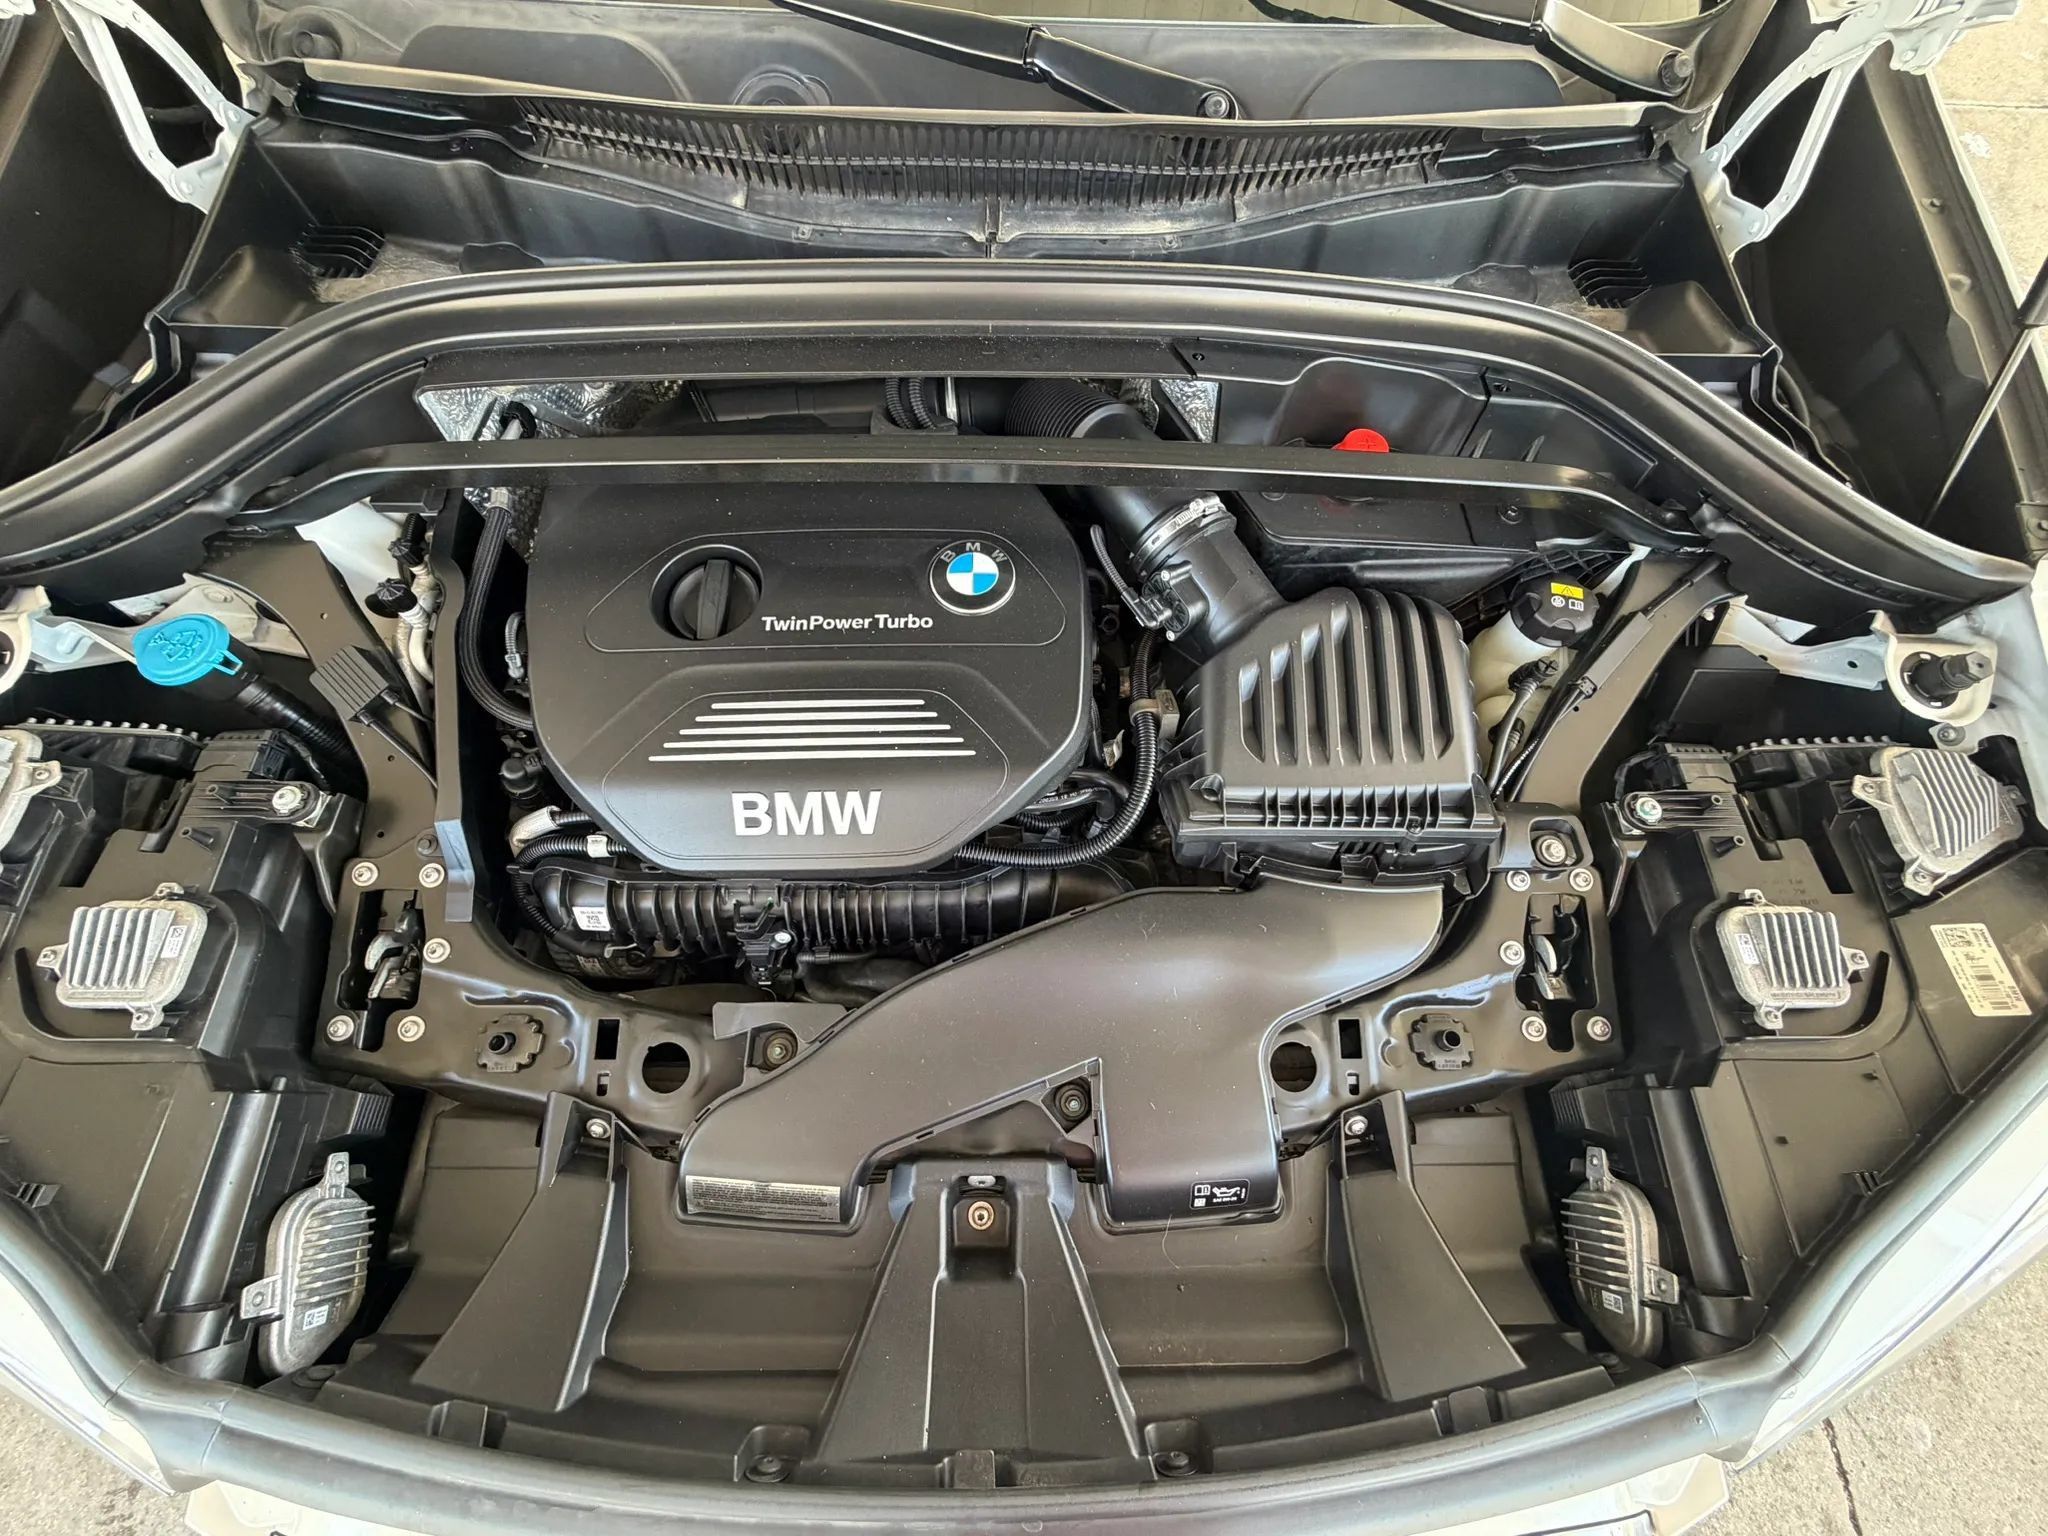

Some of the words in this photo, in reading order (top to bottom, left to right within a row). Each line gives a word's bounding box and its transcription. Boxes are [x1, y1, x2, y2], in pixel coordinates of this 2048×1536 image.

[940, 541, 1008, 564] BMW
[761, 613, 872, 632] TwinPower
[874, 613, 933, 630] Turbo
[730, 789, 882, 837] BMW
